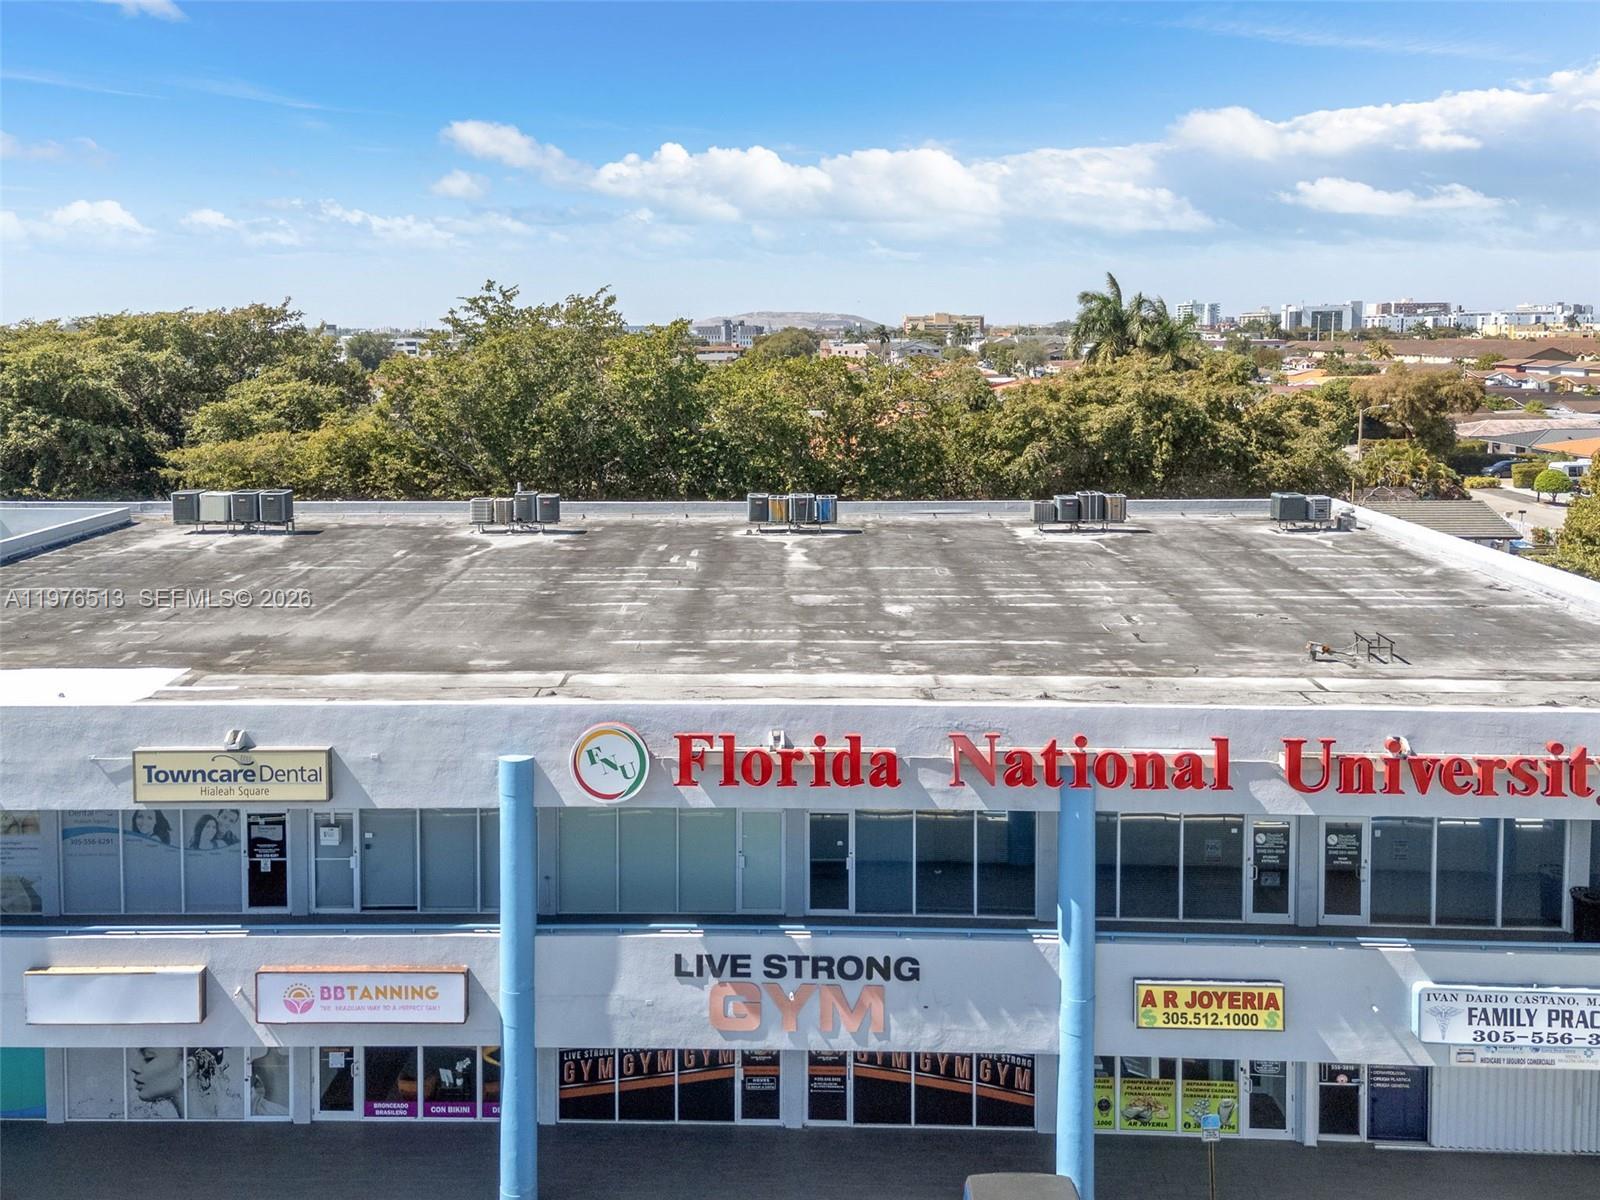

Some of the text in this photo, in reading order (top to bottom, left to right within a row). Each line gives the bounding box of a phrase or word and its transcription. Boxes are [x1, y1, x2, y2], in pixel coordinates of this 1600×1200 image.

[142, 763, 322, 784] Towncare Dental
[586, 746, 637, 780] FNU
[672, 731, 1600, 806] Florida National Universit
[200, 785, 270, 798] Hialeah Square
[674, 953, 921, 982] LIVE STRONG
[708, 982, 886, 1034] GYM
[1141, 989, 1281, 1012] A R JOYERIA
[1425, 992, 1460, 1003] IVAN
[1465, 993, 1510, 1004] DARIO
[1514, 994, 1580, 1006] CASTANO,
[1161, 1011, 1260, 1028] 305.512.1000
[1467, 1006, 1539, 1028] FAMILY
[563, 1051, 582, 1061] LIVE
[622, 1049, 673, 1077] GYM
[683, 1048, 734, 1069] GYM
[919, 1051, 971, 1080] GYM
[1000, 1054, 1033, 1068] STRONG
[1480, 1057, 1502, 1065] MEDICARE
[1506, 1057, 1527, 1066] SEGUROS
[1527, 1058, 1556, 1066] COMERCIALES
[563, 1056, 614, 1084] GYM
[979, 1058, 1031, 1091] GYM
[375, 1108, 408, 1116] BRASILEÑO
[447, 1106, 471, 1114] BIKINI
